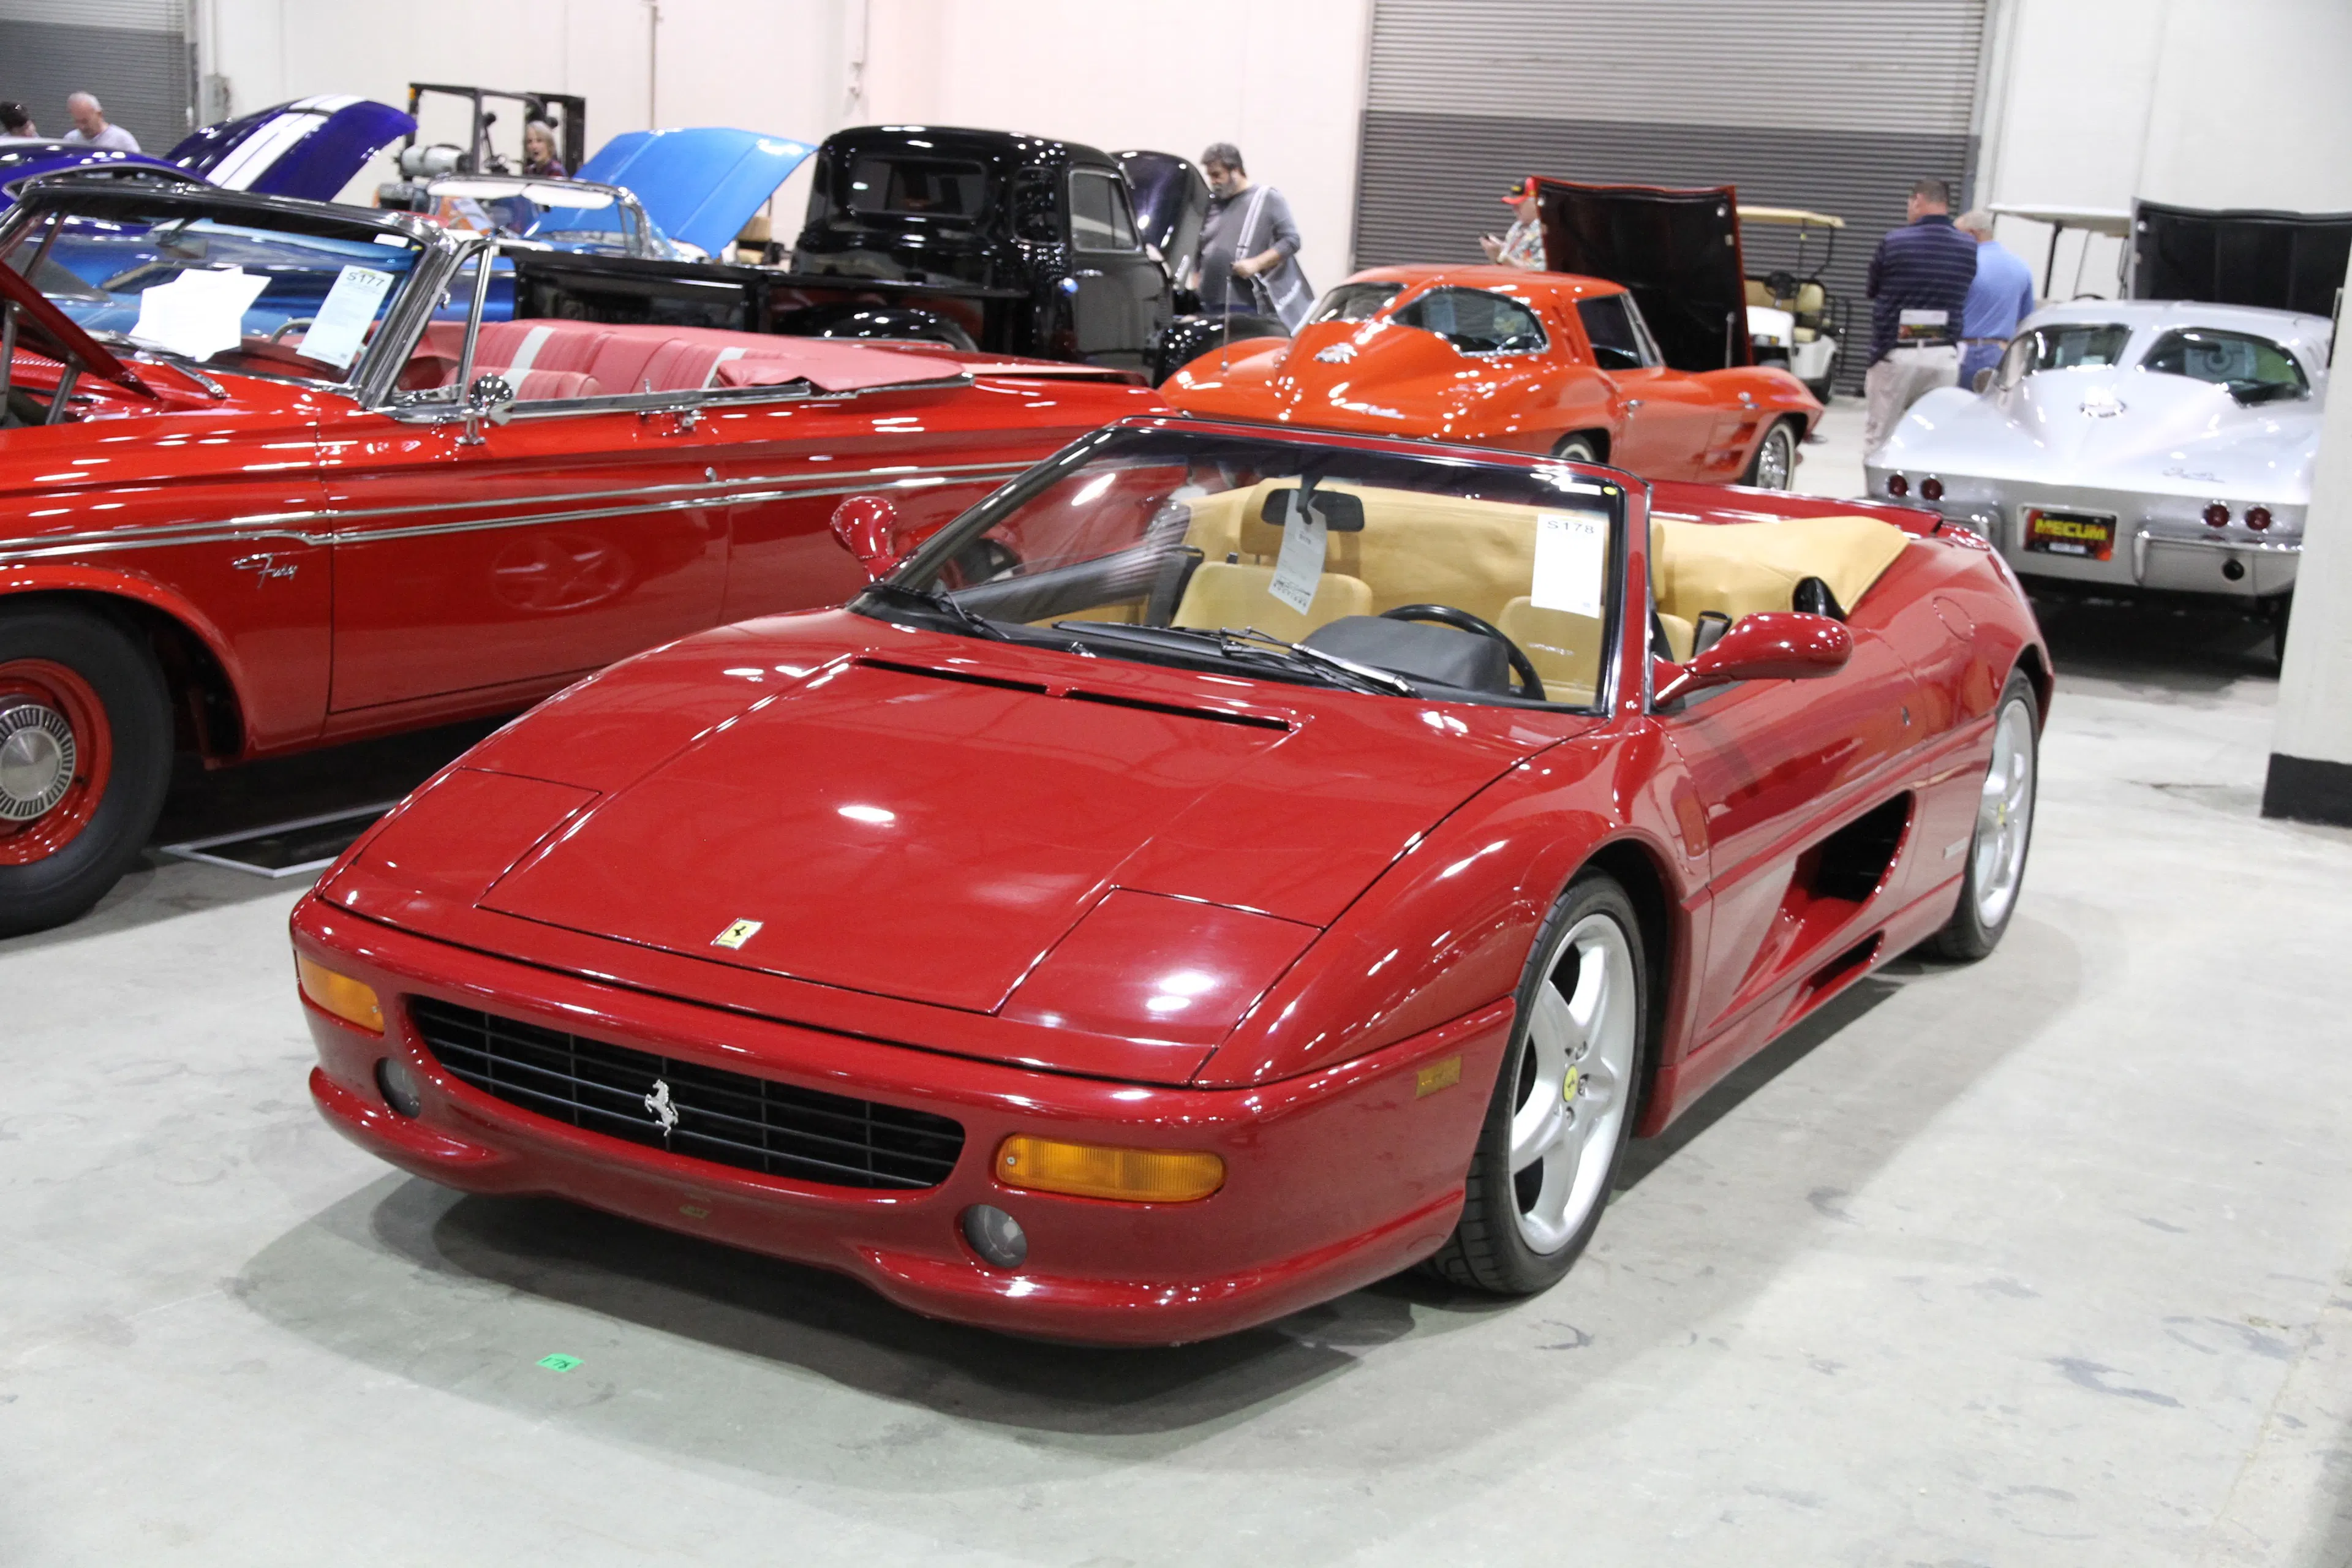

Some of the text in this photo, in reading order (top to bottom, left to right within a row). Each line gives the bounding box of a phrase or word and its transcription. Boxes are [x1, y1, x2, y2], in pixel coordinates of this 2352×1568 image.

[346, 271, 385, 287] S177
[1547, 521, 1594, 534] S178
[2035, 518, 2108, 540] MECUM
[232, 552, 298, 589] Fury
